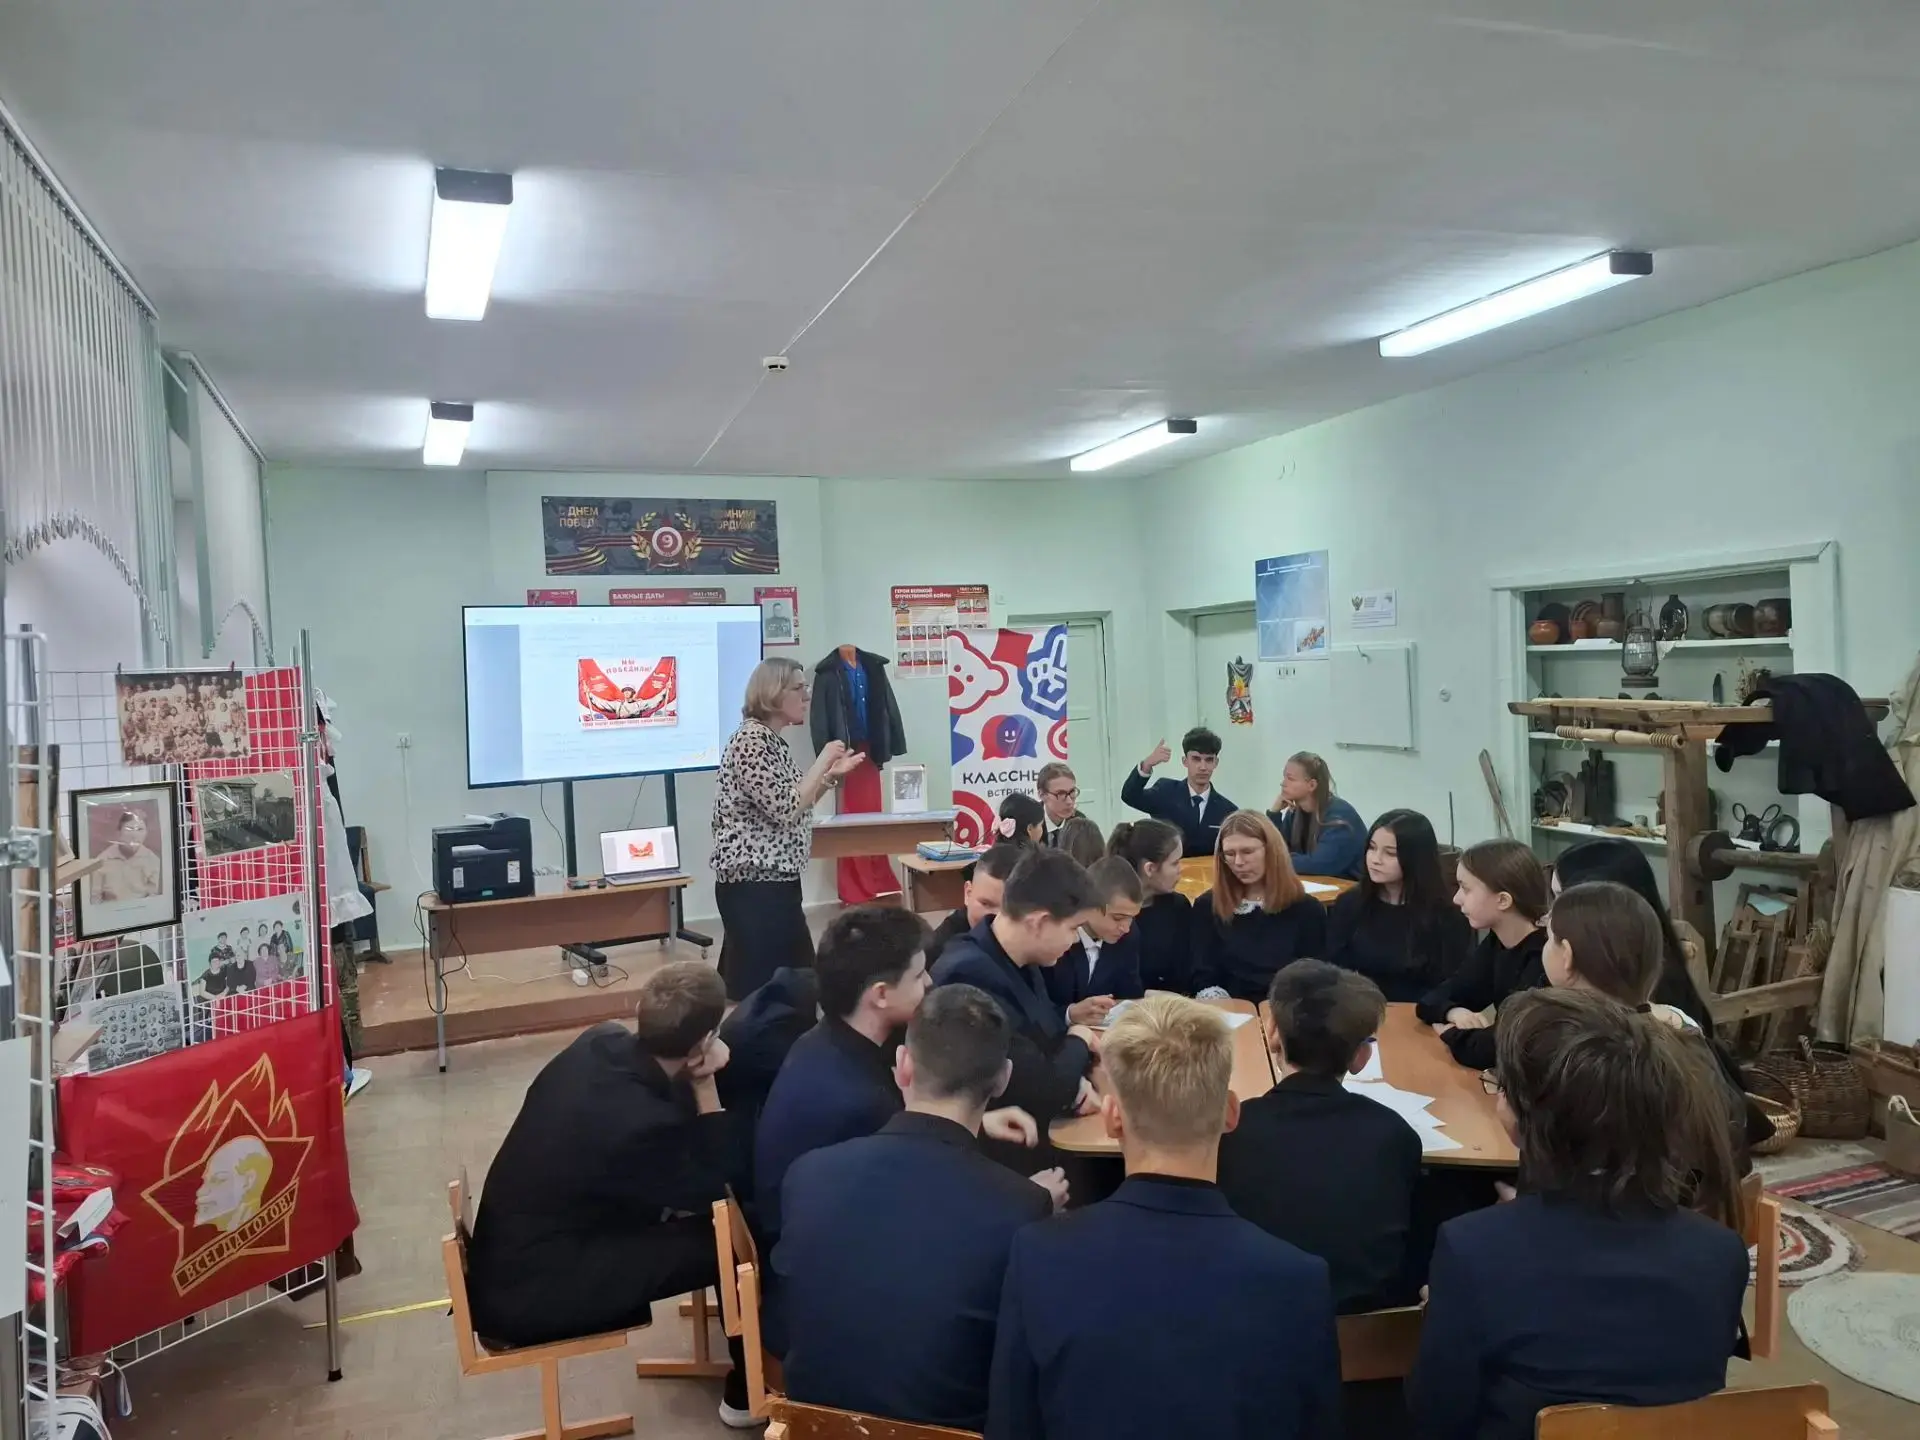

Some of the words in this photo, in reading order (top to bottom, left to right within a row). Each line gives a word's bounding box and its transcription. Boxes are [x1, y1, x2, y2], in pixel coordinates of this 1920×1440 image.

[567, 506, 599, 518] ДНЕМ
[559, 518, 601, 529] ПОБЕД
[661, 535, 673, 548] 9
[645, 592, 665, 600] ДАТЫ
[184, 1234, 244, 1280] ВСЕГДА
[245, 1192, 291, 1239] ГОТОВ!
